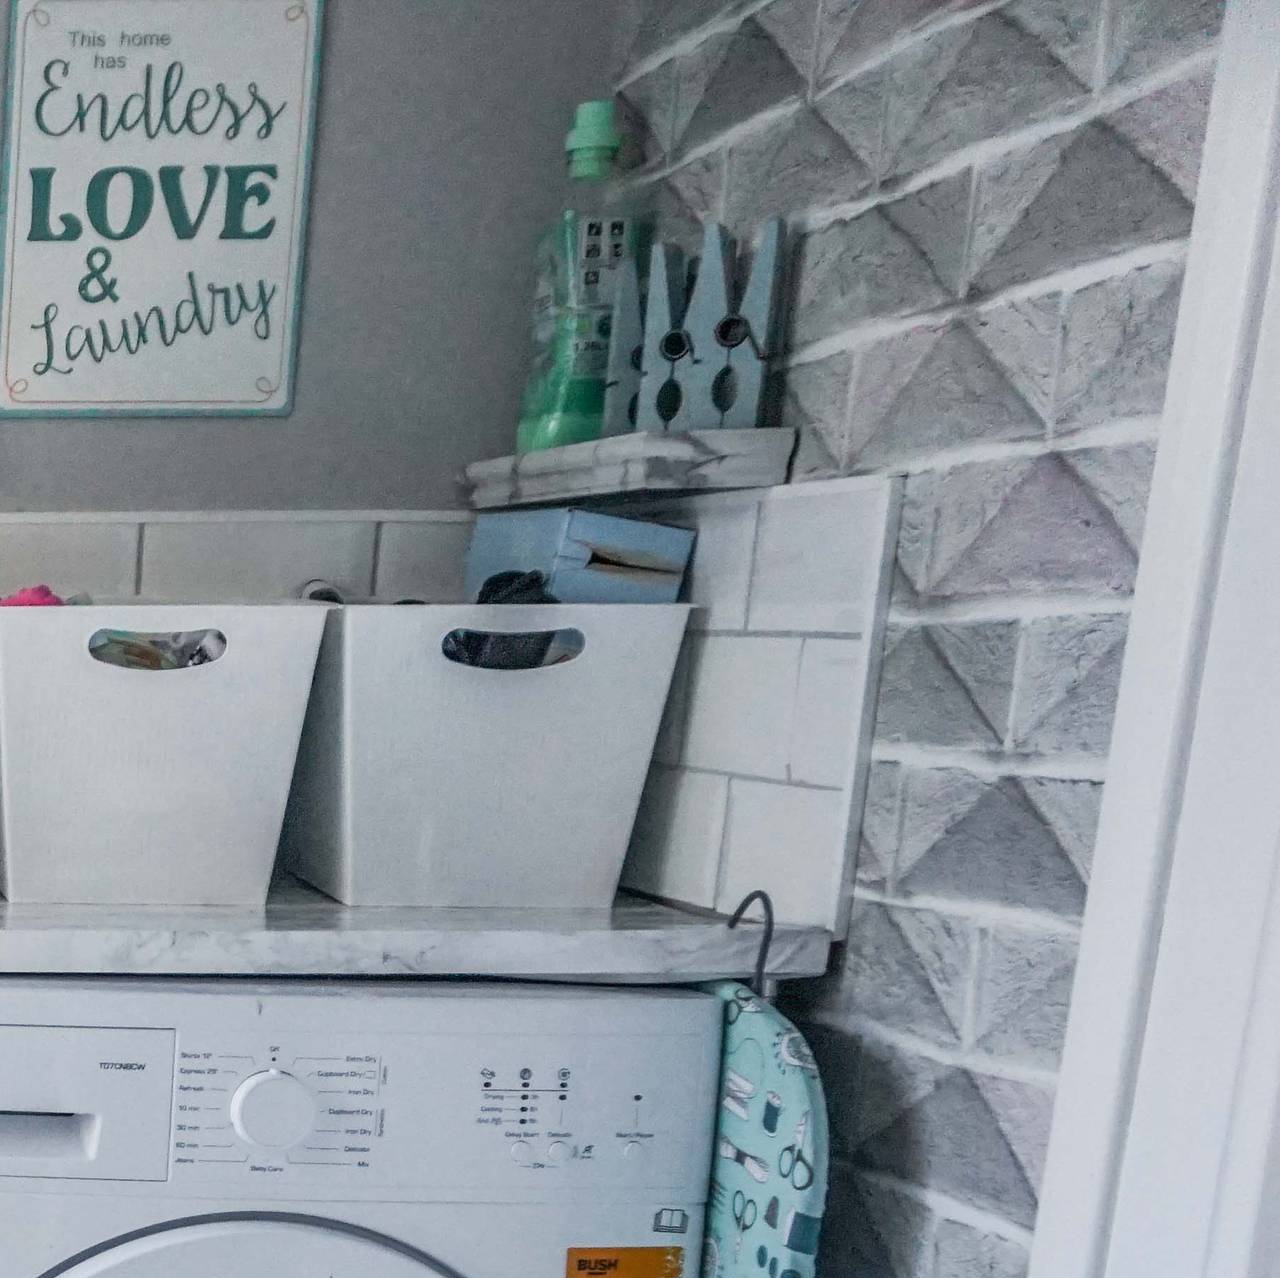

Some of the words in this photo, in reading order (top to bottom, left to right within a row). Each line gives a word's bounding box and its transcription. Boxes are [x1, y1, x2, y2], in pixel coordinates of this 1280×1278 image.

[68, 31, 107, 48] This
[120, 30, 172, 47] home
[94, 54, 127, 69] has
[35, 58, 287, 142] Endless
[27, 164, 278, 241] LOVE
[78, 246, 120, 304] &
[31, 271, 276, 376] Laundry
[577, 1259, 618, 1271] BUSH
